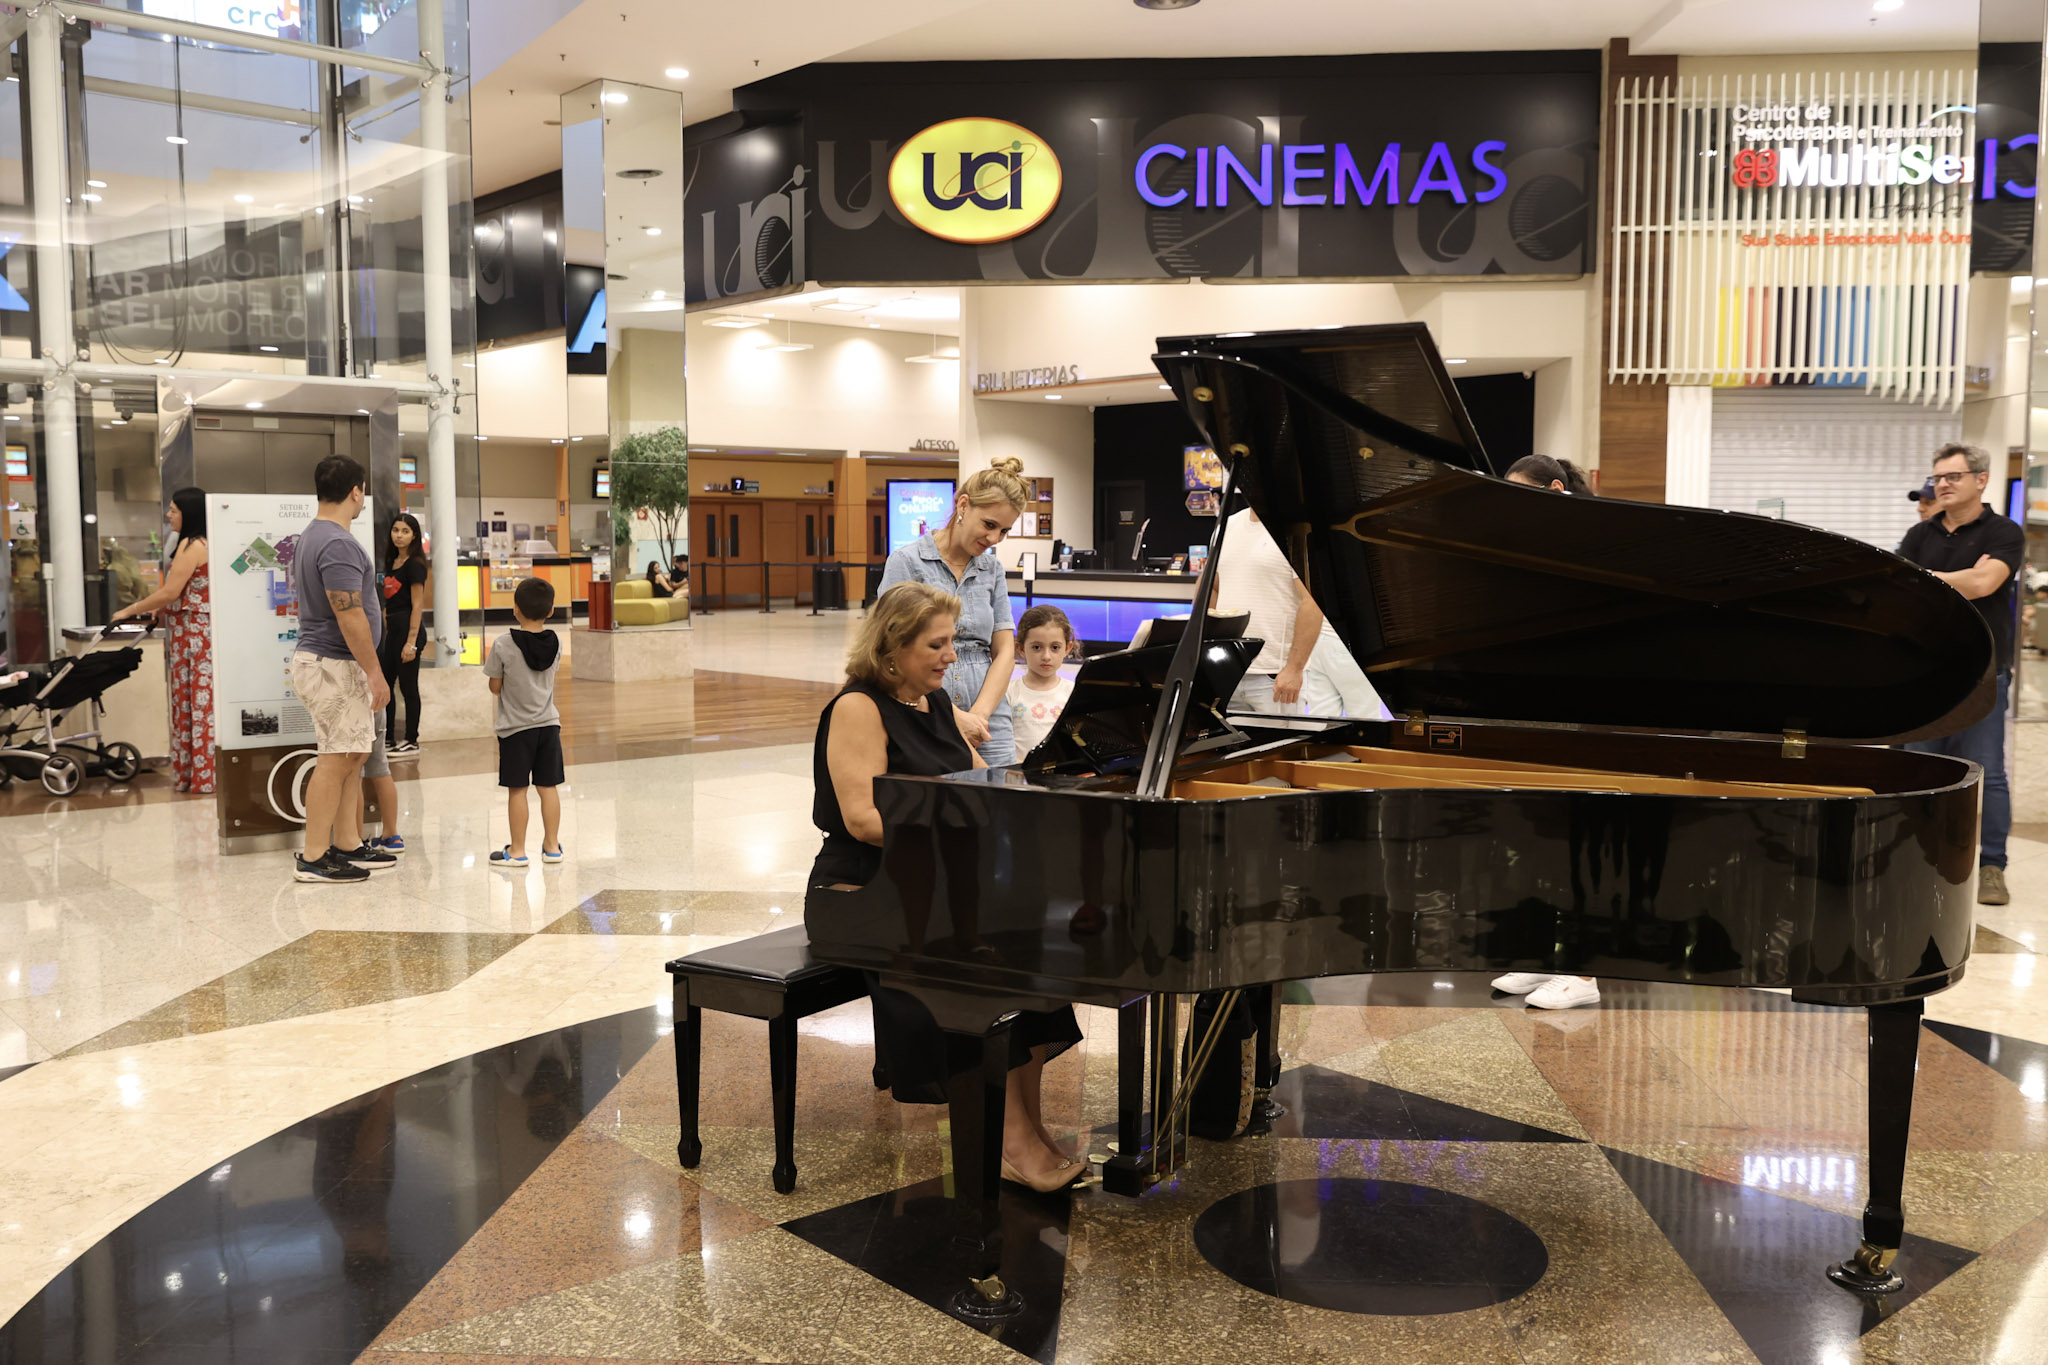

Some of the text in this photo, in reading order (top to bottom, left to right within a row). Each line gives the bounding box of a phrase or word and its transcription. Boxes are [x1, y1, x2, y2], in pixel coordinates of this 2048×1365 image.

[1733, 103, 1831, 122] Centro de
[1733, 123, 1963, 142] Psicoterapia e Treinamento
[1134, 141, 1508, 208] CINEMAS
[1742, 234, 1769, 247] Sua
[1824, 232, 1900, 246] Emocional
[916, 438, 955, 451] ACESSO
[735, 479, 742, 489] 7
[899, 504, 941, 514] ONLINE
